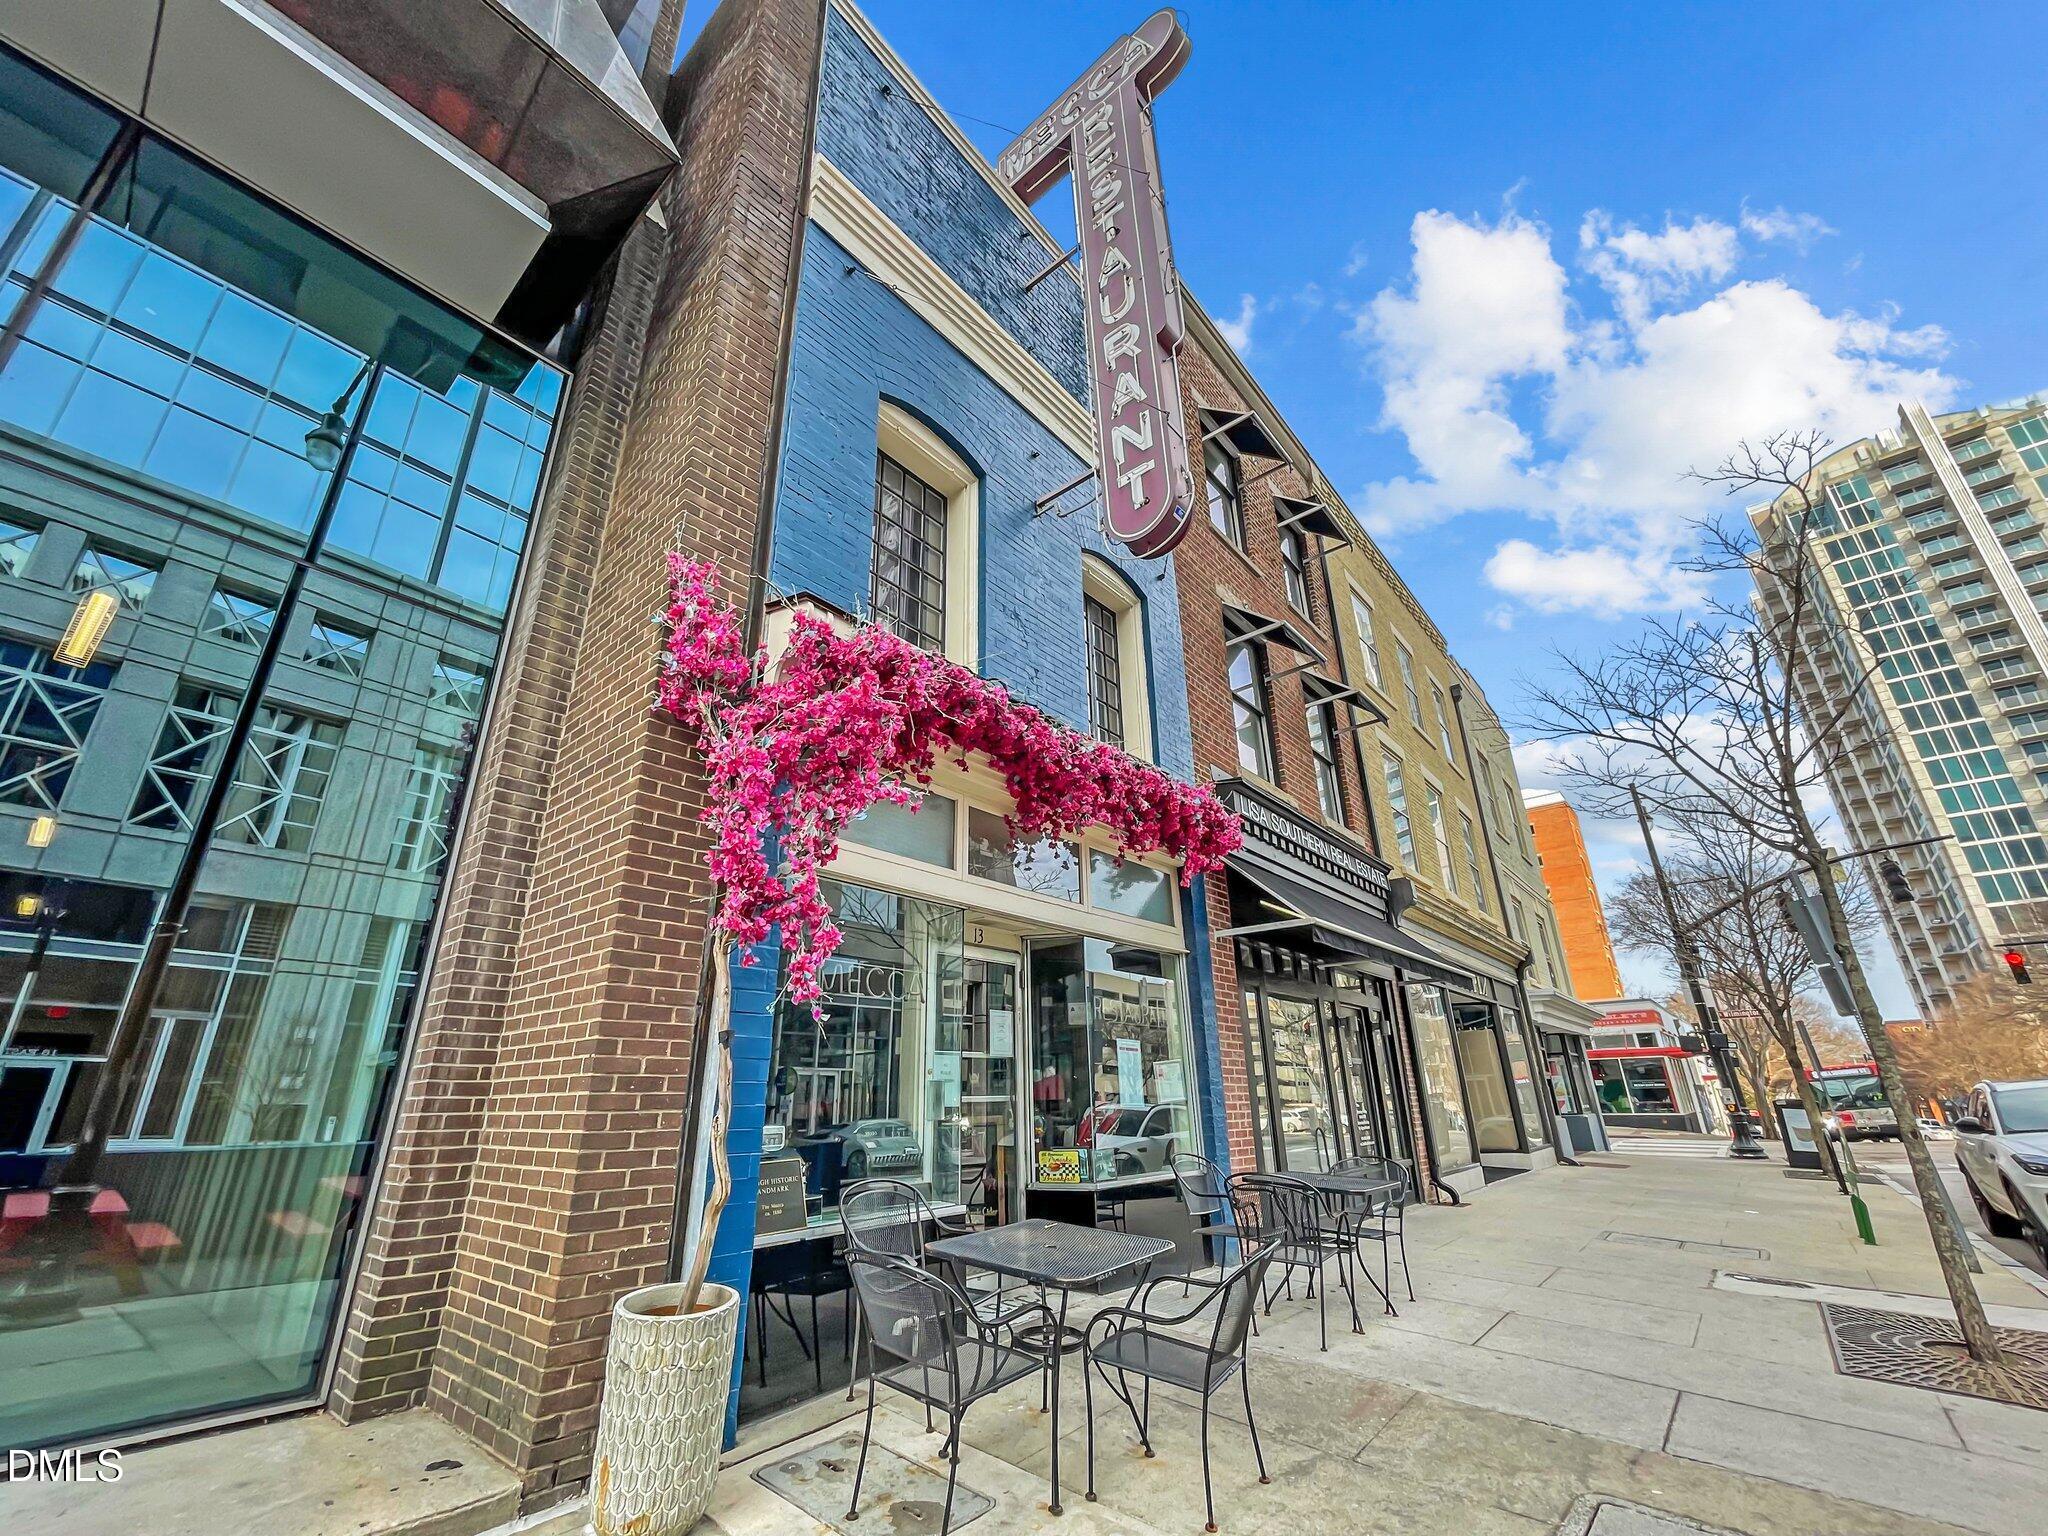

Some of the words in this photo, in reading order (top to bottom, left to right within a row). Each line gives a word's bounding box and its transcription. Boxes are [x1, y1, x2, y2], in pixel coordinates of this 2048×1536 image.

[1004, 37, 1155, 181] MECCA
[1082, 101, 1156, 511] RESTAURANT
[1240, 796, 1269, 826] LISA
[1270, 812, 1330, 860] SOUTHERN
[1330, 846, 1356, 874] REAL
[1356, 860, 1389, 891] ESTATE
[973, 927, 984, 944] 13
[822, 964, 925, 1003] MECCA
[770, 1175, 799, 1185] HISTORIC
